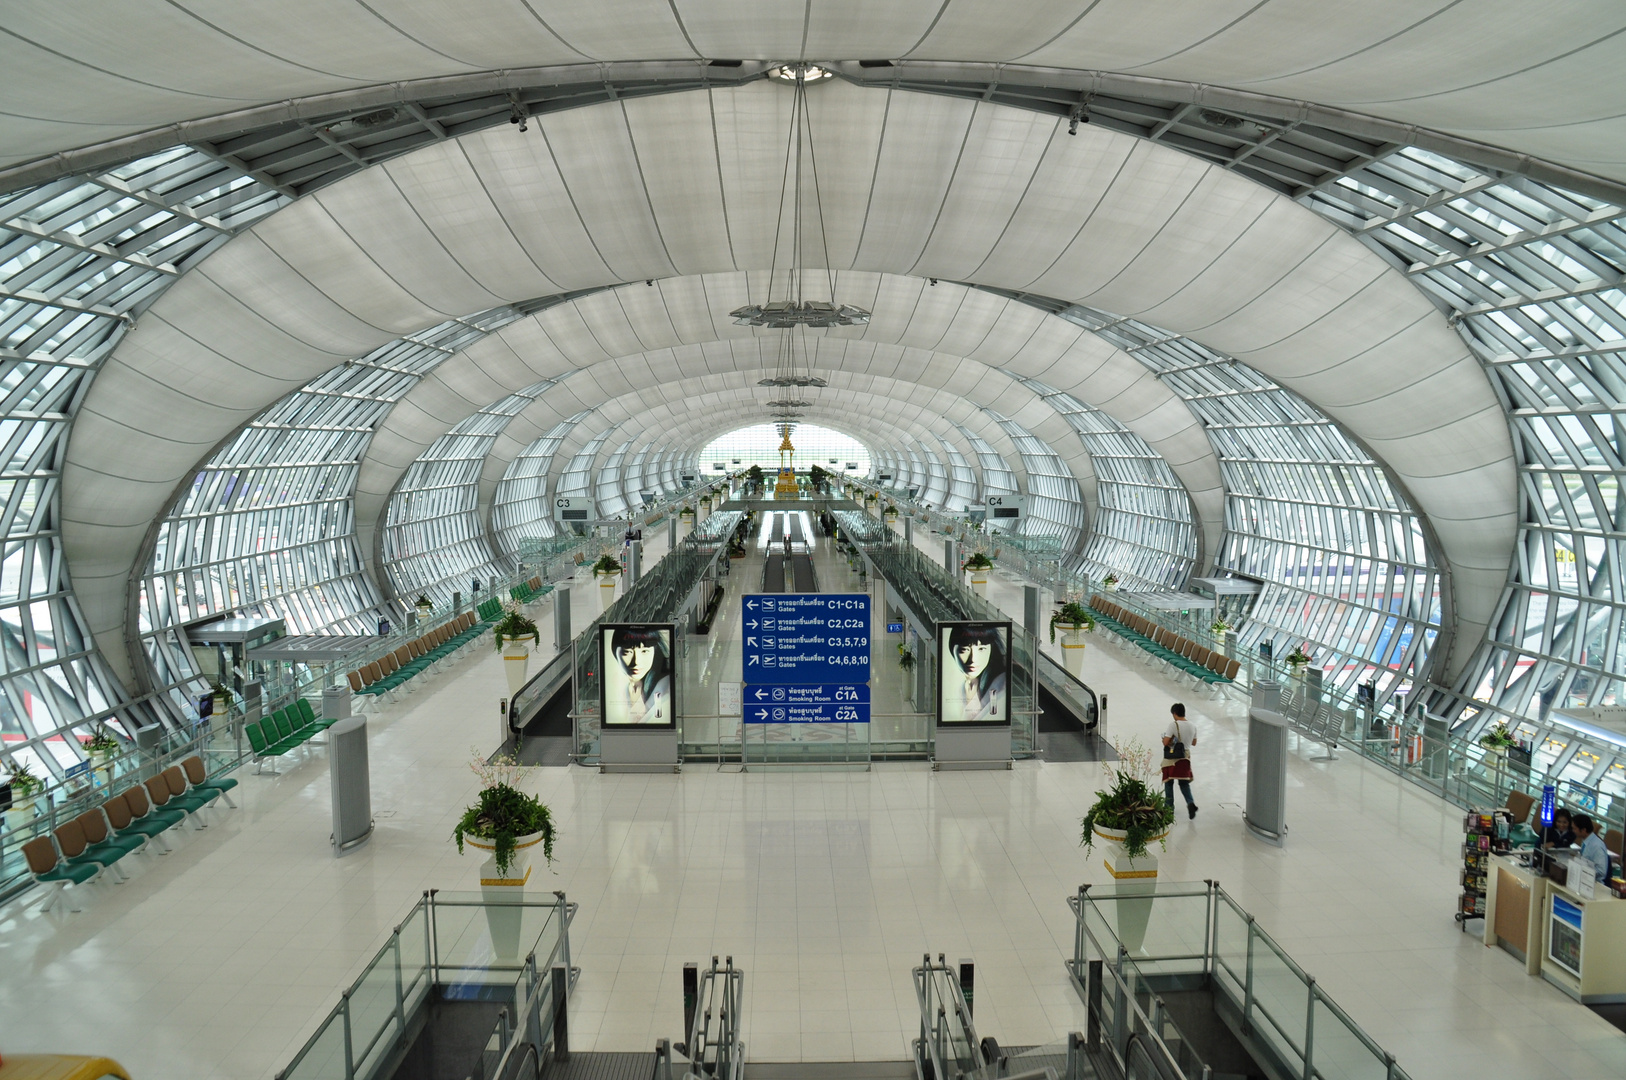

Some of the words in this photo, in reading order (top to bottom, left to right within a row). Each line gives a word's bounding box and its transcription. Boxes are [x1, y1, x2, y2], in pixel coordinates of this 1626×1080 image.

[557, 499, 570, 507] C3
[989, 497, 1002, 506] C4
[828, 601, 864, 609] C1-C1a
[828, 619, 863, 629] C2,C2a
[828, 638, 867, 647] C3,5,7,9
[828, 656, 868, 666] C4,6,8,10
[835, 692, 858, 700] C1A
[835, 711, 858, 720] C2A
